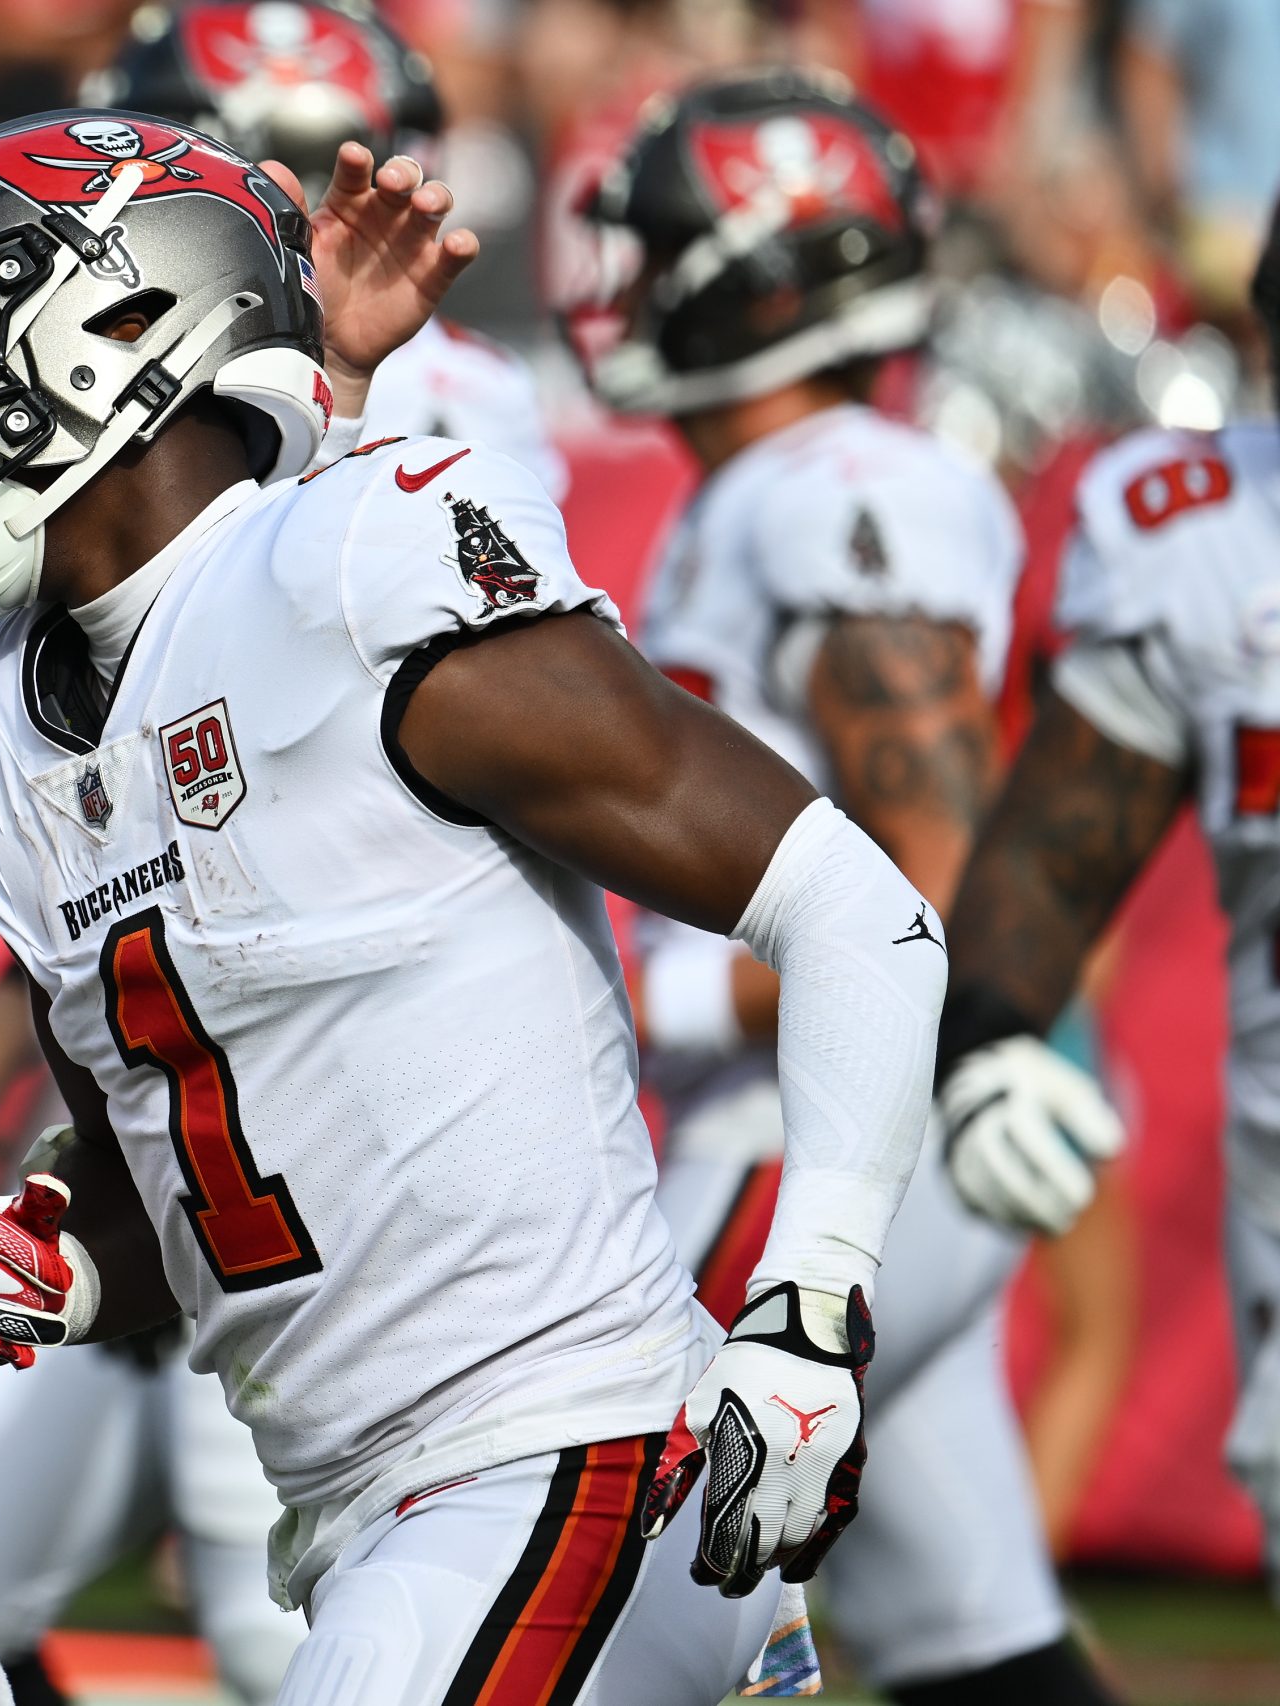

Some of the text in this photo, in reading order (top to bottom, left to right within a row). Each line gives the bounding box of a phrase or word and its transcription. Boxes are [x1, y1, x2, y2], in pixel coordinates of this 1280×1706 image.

[168, 716, 228, 787] 50
[188, 774, 224, 796] SEASONS
[83, 790, 107, 818] NFL
[57, 840, 186, 941] BUCCANEERS
[99, 904, 323, 1293] 1
